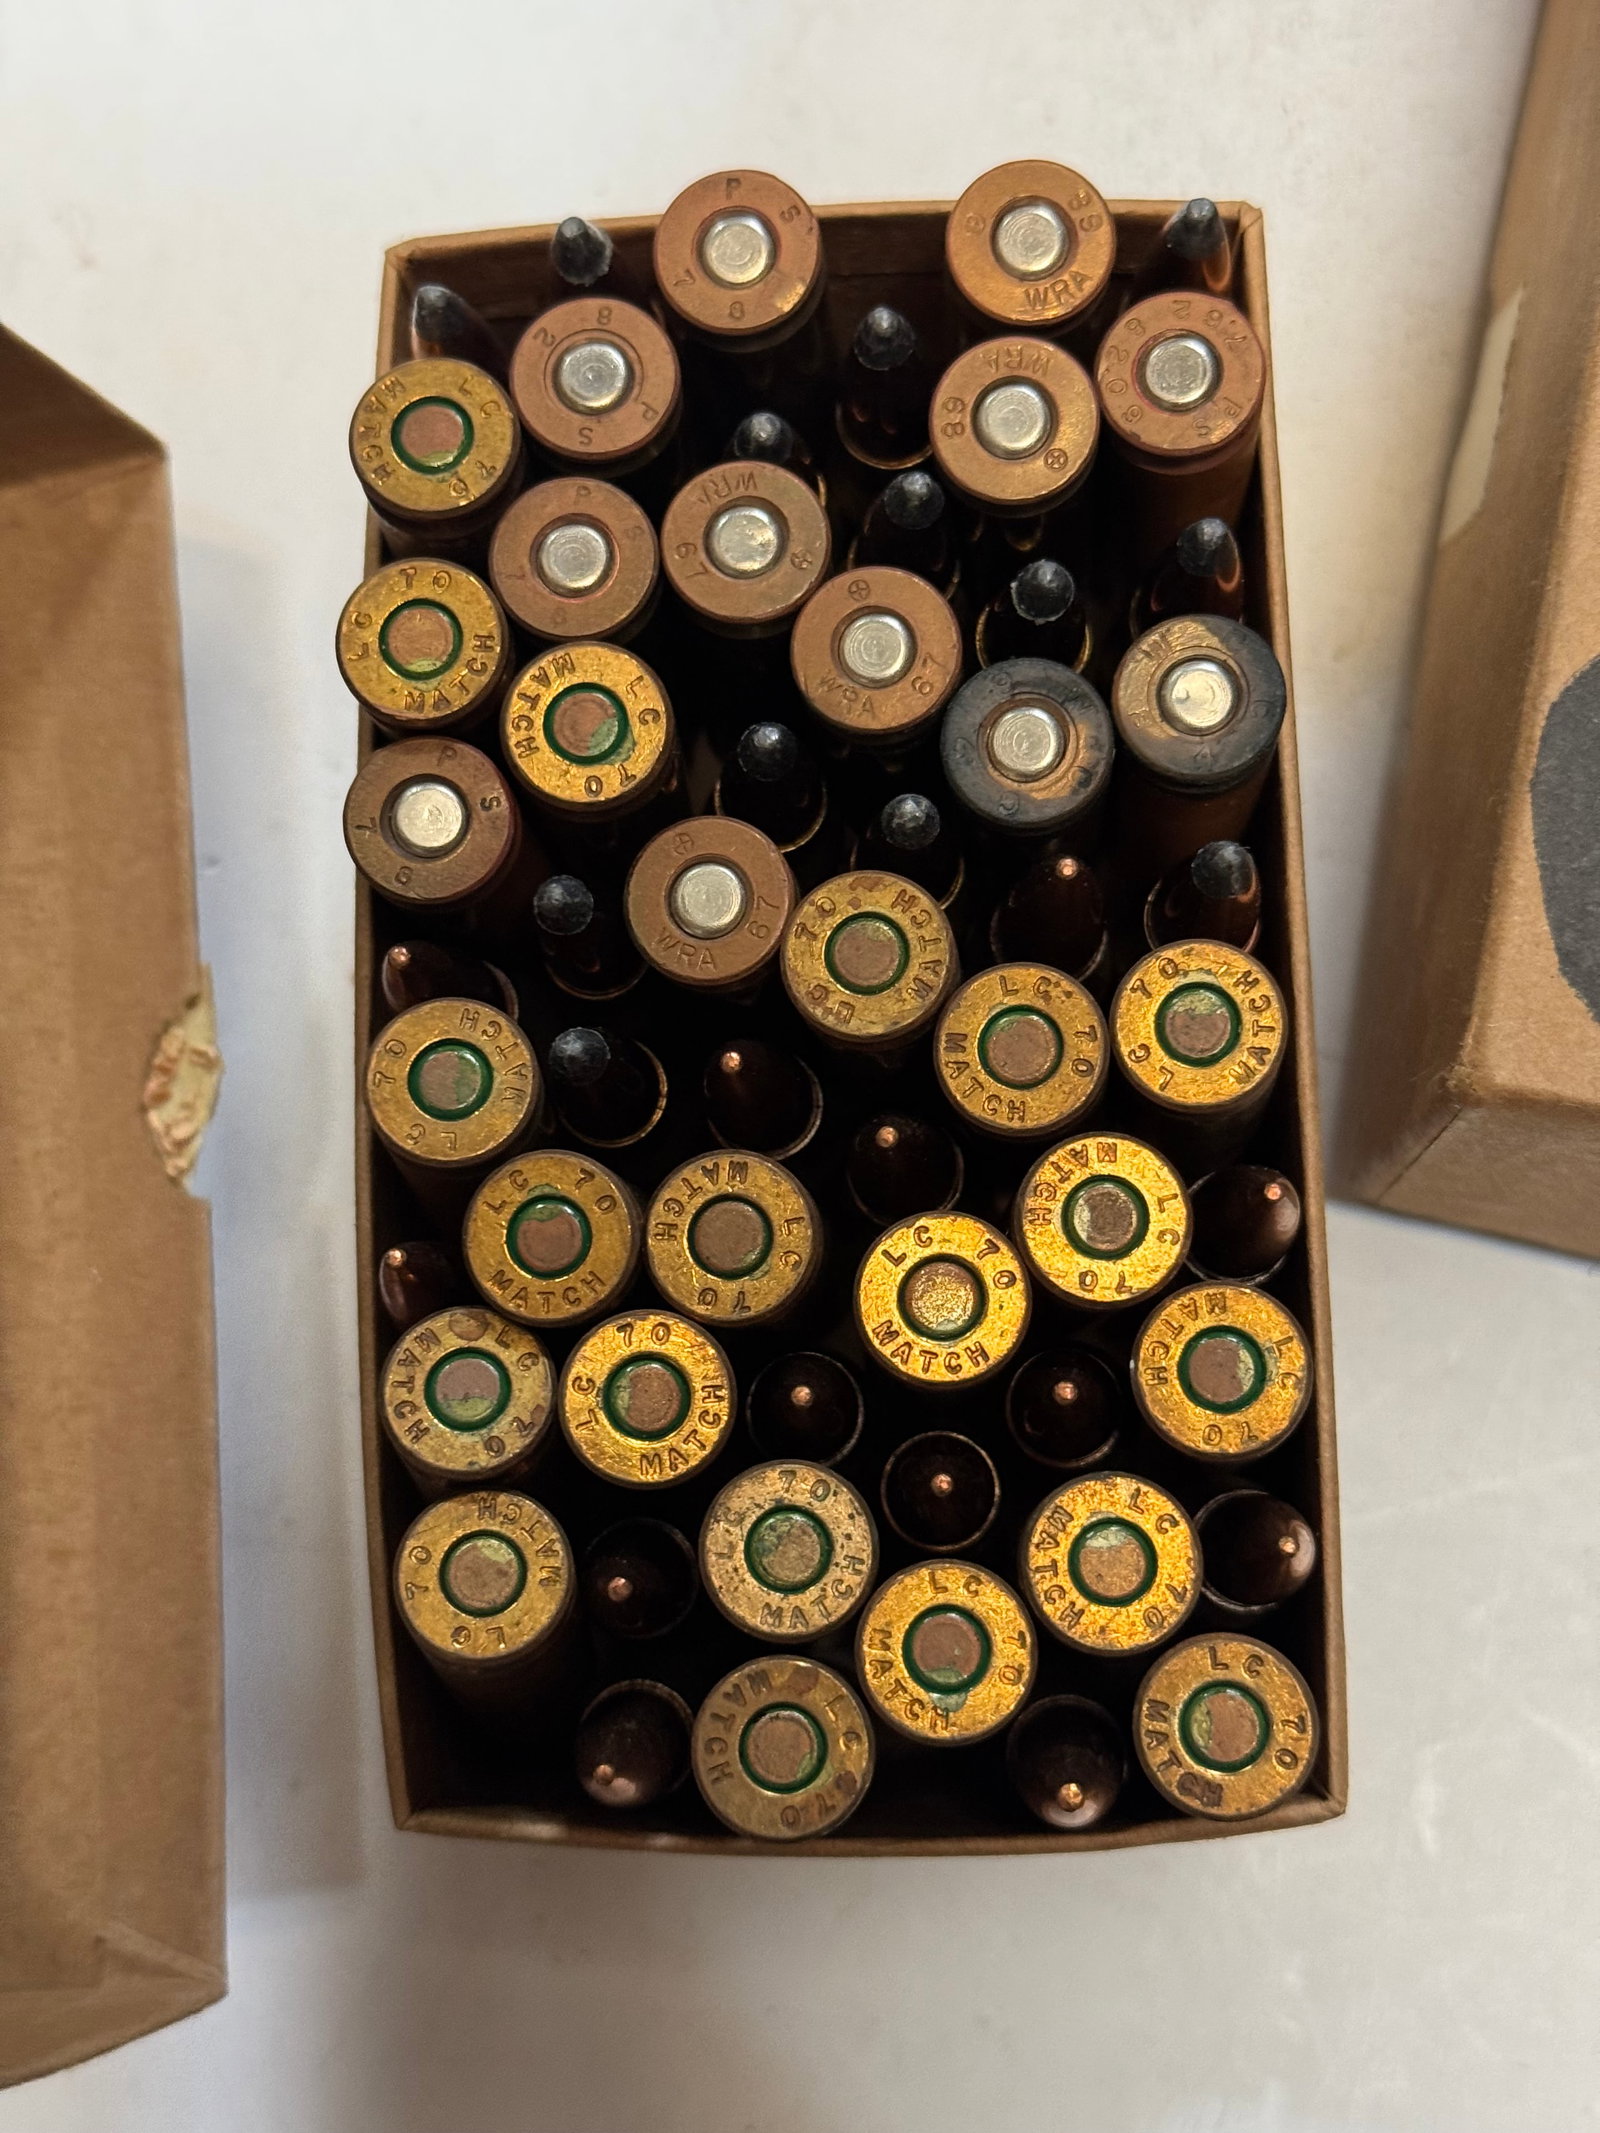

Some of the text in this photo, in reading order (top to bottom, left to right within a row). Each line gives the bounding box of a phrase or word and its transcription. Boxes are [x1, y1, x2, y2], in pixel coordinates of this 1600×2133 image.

[1024, 270, 1093, 311] WRA
[981, 345, 1053, 377] WRA
[358, 376, 406, 485] MATCH
[697, 471, 759, 505] WRA
[404, 634, 496, 714] MATCH
[512, 653, 576, 759] MATCH
[655, 924, 718, 972] WRA
[890, 888, 944, 1001] MATCH
[459, 1008, 529, 1103] MATCH
[1229, 970, 1277, 1084] MATCH
[943, 1032, 1027, 1123] MATCH
[653, 1159, 750, 1242] MATCH
[1027, 1141, 1118, 1226] MATCH
[489, 1269, 606, 1315] MATCH
[873, 1319, 990, 1376] MATCH
[1144, 1291, 1227, 1387] MATCH
[391, 1327, 443, 1444] MATCH
[639, 1384, 726, 1476] MATCH
[478, 1496, 562, 1587] MATCH
[1033, 1506, 1085, 1627] MATCH
[759, 1554, 866, 1630] MATCH
[868, 1629, 950, 1732] MATCH
[704, 1670, 772, 1785] MATCH
